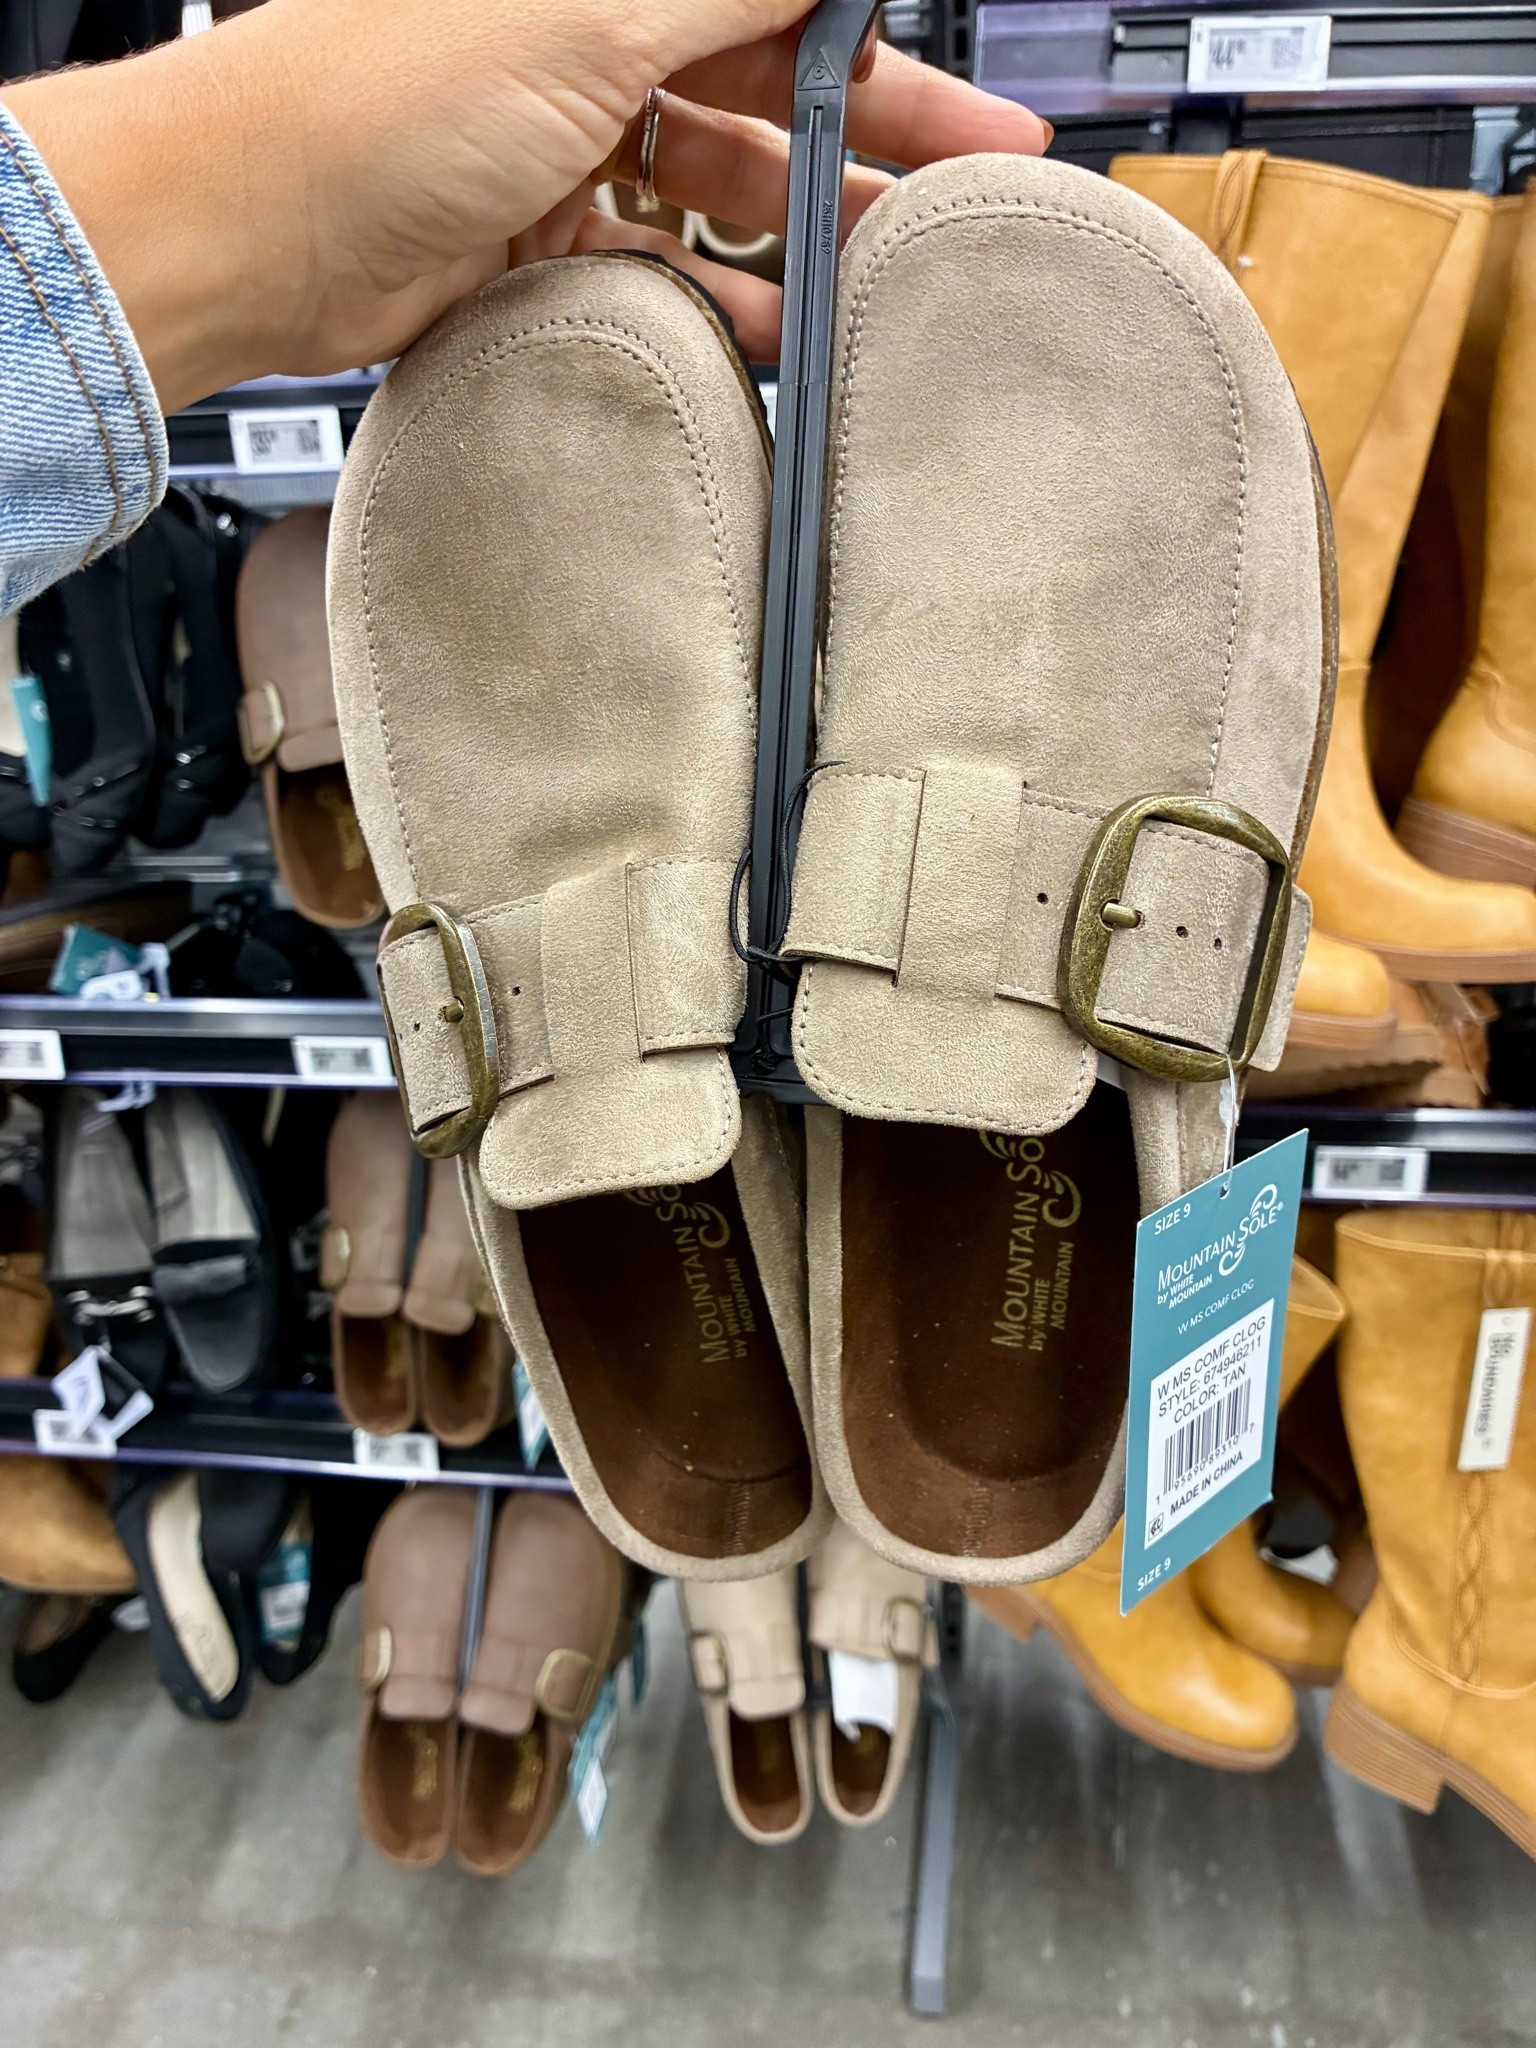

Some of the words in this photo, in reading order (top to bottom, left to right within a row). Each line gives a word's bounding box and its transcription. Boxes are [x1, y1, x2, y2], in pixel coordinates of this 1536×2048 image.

[1006, 1137, 1045, 1186] SO
[1154, 1211, 1182, 1235] SIZE
[1183, 1203, 1192, 1218] 9
[990, 1191, 1040, 1348] MOUNTAIN
[1158, 1230, 1236, 1292] MOUNTAIN
[1238, 1209, 1277, 1243] SOLE
[672, 1226, 731, 1364] MOUNTAIN
[724, 1257, 756, 1333] MOUNTAIN
[1031, 1279, 1050, 1325] WHITE
[1050, 1241, 1074, 1330] MOUNTAIN
[1157, 1291, 1169, 1305] by
[1170, 1274, 1194, 1295] WHITE
[1168, 1274, 1213, 1309] MOUNTAIN
[1204, 1294, 1231, 1319] COMF
[1231, 1279, 1255, 1301] CLOG
[719, 1295, 741, 1336] WHITE
[1028, 1330, 1047, 1351] by
[1194, 1338, 1231, 1372] COMF
[1232, 1315, 1267, 1347] CLOG
[1158, 1378, 1201, 1418] STYLE:
[1203, 1333, 1262, 1384] 674946211
[1174, 1384, 1220, 1424] COLOR:
[1223, 1362, 1247, 1388] TAN
[1170, 1483, 1200, 1516] MADE
[1201, 1475, 1211, 1492] IN
[1213, 1450, 1244, 1482] CHINA
[1137, 1566, 1162, 1591] SIZE
[1164, 1557, 1172, 1570] 9
